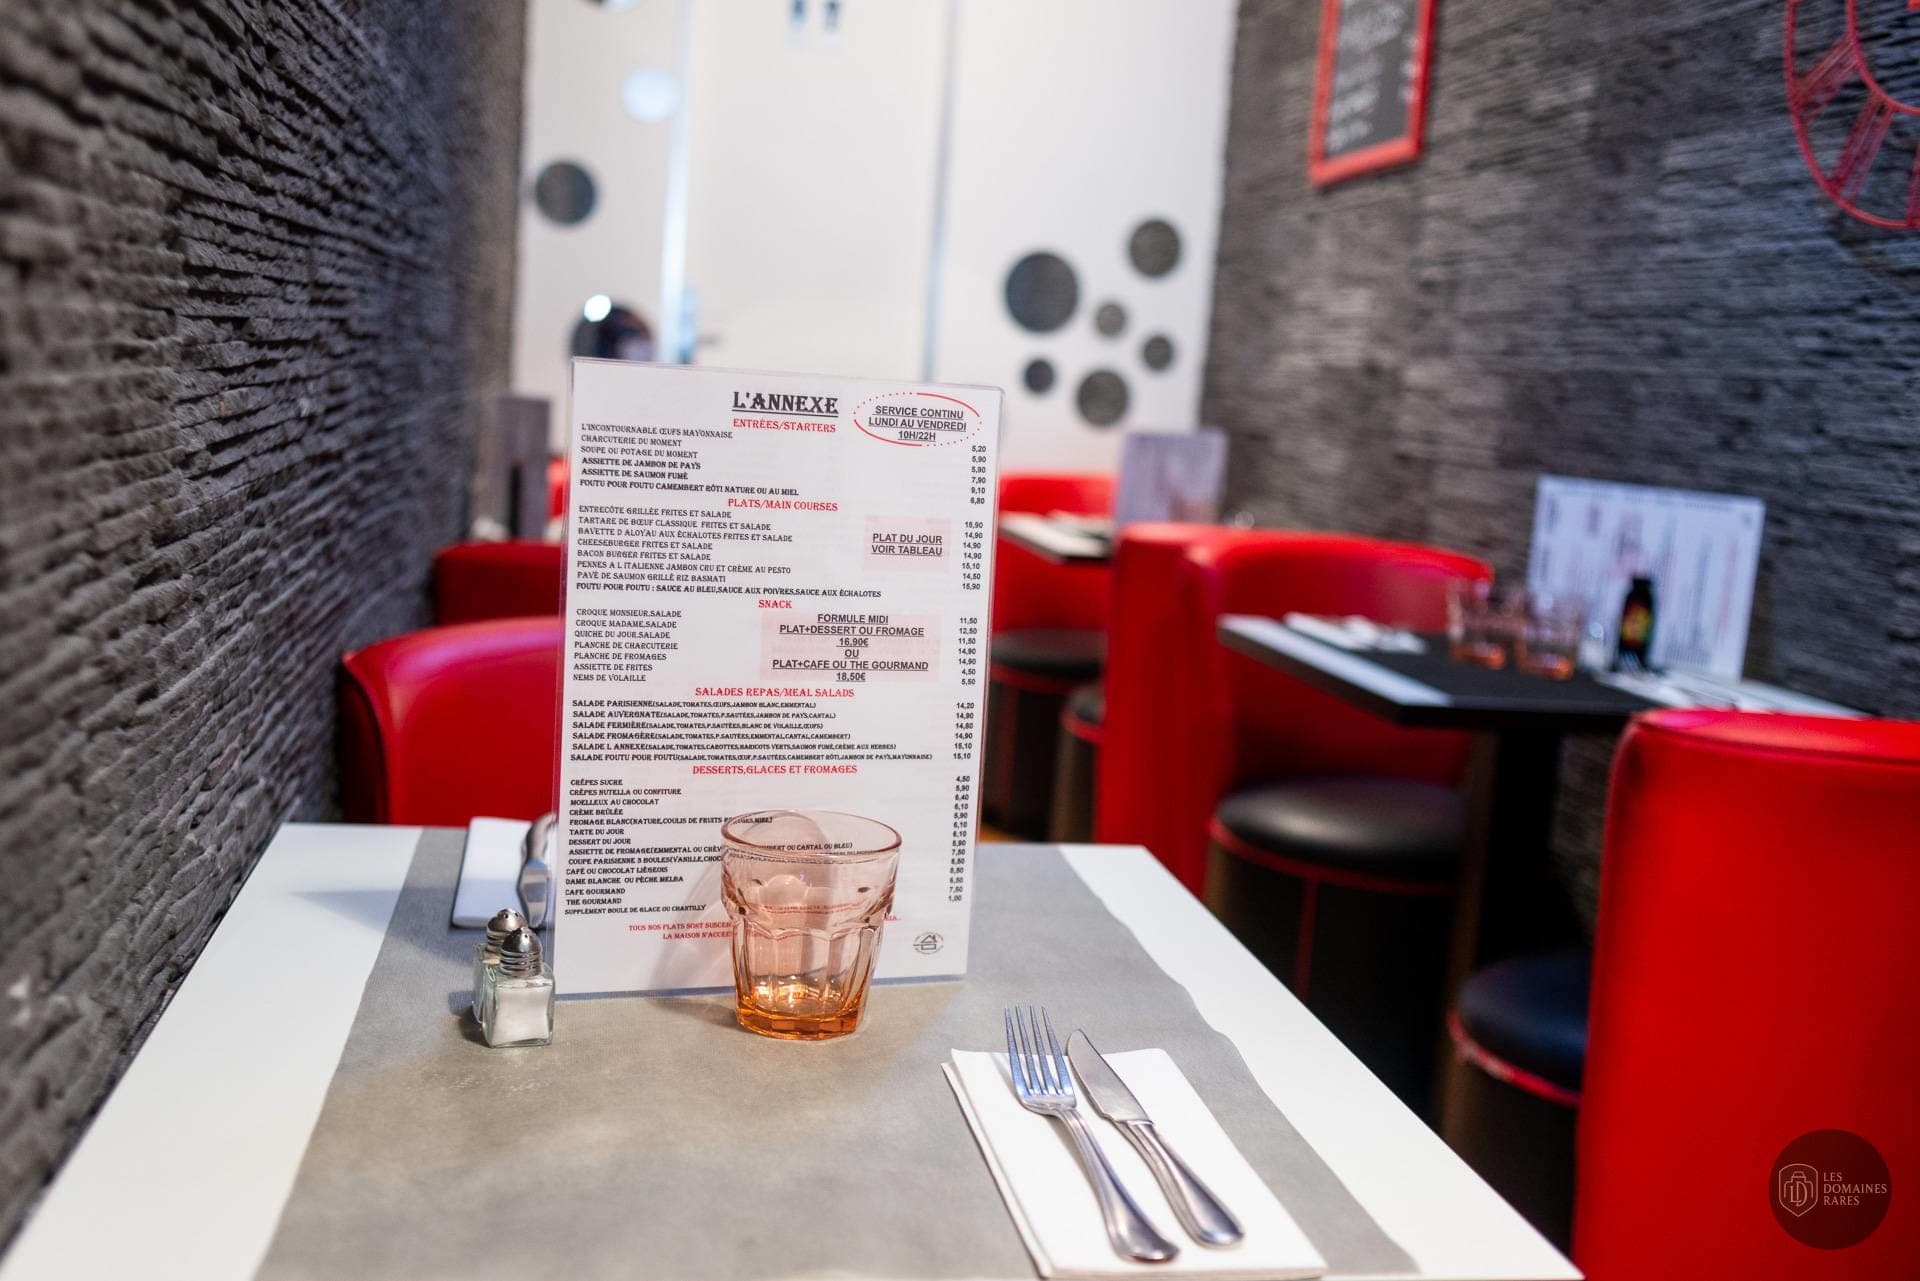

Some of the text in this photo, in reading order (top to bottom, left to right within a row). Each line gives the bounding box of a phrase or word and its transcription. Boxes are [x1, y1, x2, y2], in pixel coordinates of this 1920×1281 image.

[732, 391, 838, 416] L'ANNEXE
[875, 405, 964, 421] SERVICE CONTINU
[868, 417, 966, 432] LUNDI AU VENDREDI
[682, 429, 733, 439] MAYONNAISE
[899, 430, 936, 442] 10H/22H
[581, 434, 682, 447] CHARCUTERIE DU MOMENT
[580, 445, 698, 459] SOUPE OU POTAGE DU MOMENT
[972, 445, 987, 453] 5,20
[582, 457, 620, 466] ASSIETTE
[634, 460, 666, 468] JAMBON
[668, 461, 678, 469] DE
[680, 461, 701, 470] PAYS
[581, 468, 620, 477] ASSIETTE
[634, 470, 666, 479] SAUMON
[580, 479, 605, 487] FOUTU
[606, 480, 628, 488] POUR
[629, 481, 654, 489] FOUTU
[655, 482, 704, 492] CAMEMBERT
[724, 486, 755, 494] NATURE
[756, 487, 767, 495] OU
[781, 488, 799, 496] MIEL
[727, 498, 838, 512] PLATS/MAIN COURSES
[661, 508, 688, 517] FRITES
[700, 510, 732, 518] SALADE
[579, 516, 617, 525] TARTARE
[618, 518, 629, 526] DE
[655, 519, 698, 528] CLASSIQUE
[701, 521, 728, 529] FRITES
[729, 522, 739, 530] ET
[740, 522, 771, 531] SALADE
[578, 527, 615, 536] BAVETTE
[624, 529, 657, 537] ALOYAU
[659, 530, 675, 538] AUX
[723, 532, 750, 541] FRITES
[751, 533, 761, 541] ET
[762, 534, 792, 542] SALADE
[872, 533, 942, 546] PLAT DU JOUR
[577, 549, 711, 561] BACON BURGER FRITES ET SALADE
[872, 544, 942, 557] VOIR TABLEAU
[624, 562, 664, 570] ITALIENNE
[666, 563, 698, 571] JAMBON
[716, 564, 725, 572] ET
[768, 566, 791, 574] PESTO
[962, 562, 980, 570] 15,10
[613, 572, 646, 580] SAUMON
[676, 574, 689, 582] RIZ
[691, 575, 726, 583] BASMATI
[758, 599, 792, 609] SNACK
[576, 608, 608, 616] CROQUE
[576, 619, 607, 627] CROQUE
[817, 613, 888, 625] FORMULE MIDI
[574, 630, 615, 638] QUICHE DU
[779, 624, 924, 638] PLAT+DESSERT OU FROMAGE
[574, 641, 610, 649] PLANCHE
[624, 642, 678, 650] CHARCUTERIE
[574, 652, 610, 660] PLANCHE
[612, 652, 622, 660] DE
[844, 649, 859, 659] OU
[574, 663, 612, 671] ASSIETTE
[772, 659, 928, 672] PLAT+CAFE OU THE GOURMAND
[596, 674, 606, 682] DE
[608, 674, 646, 682] VOLAILLE
[695, 687, 854, 697] SALADES REPAS/MEAL SALADS
[955, 732, 973, 740] 14,90
